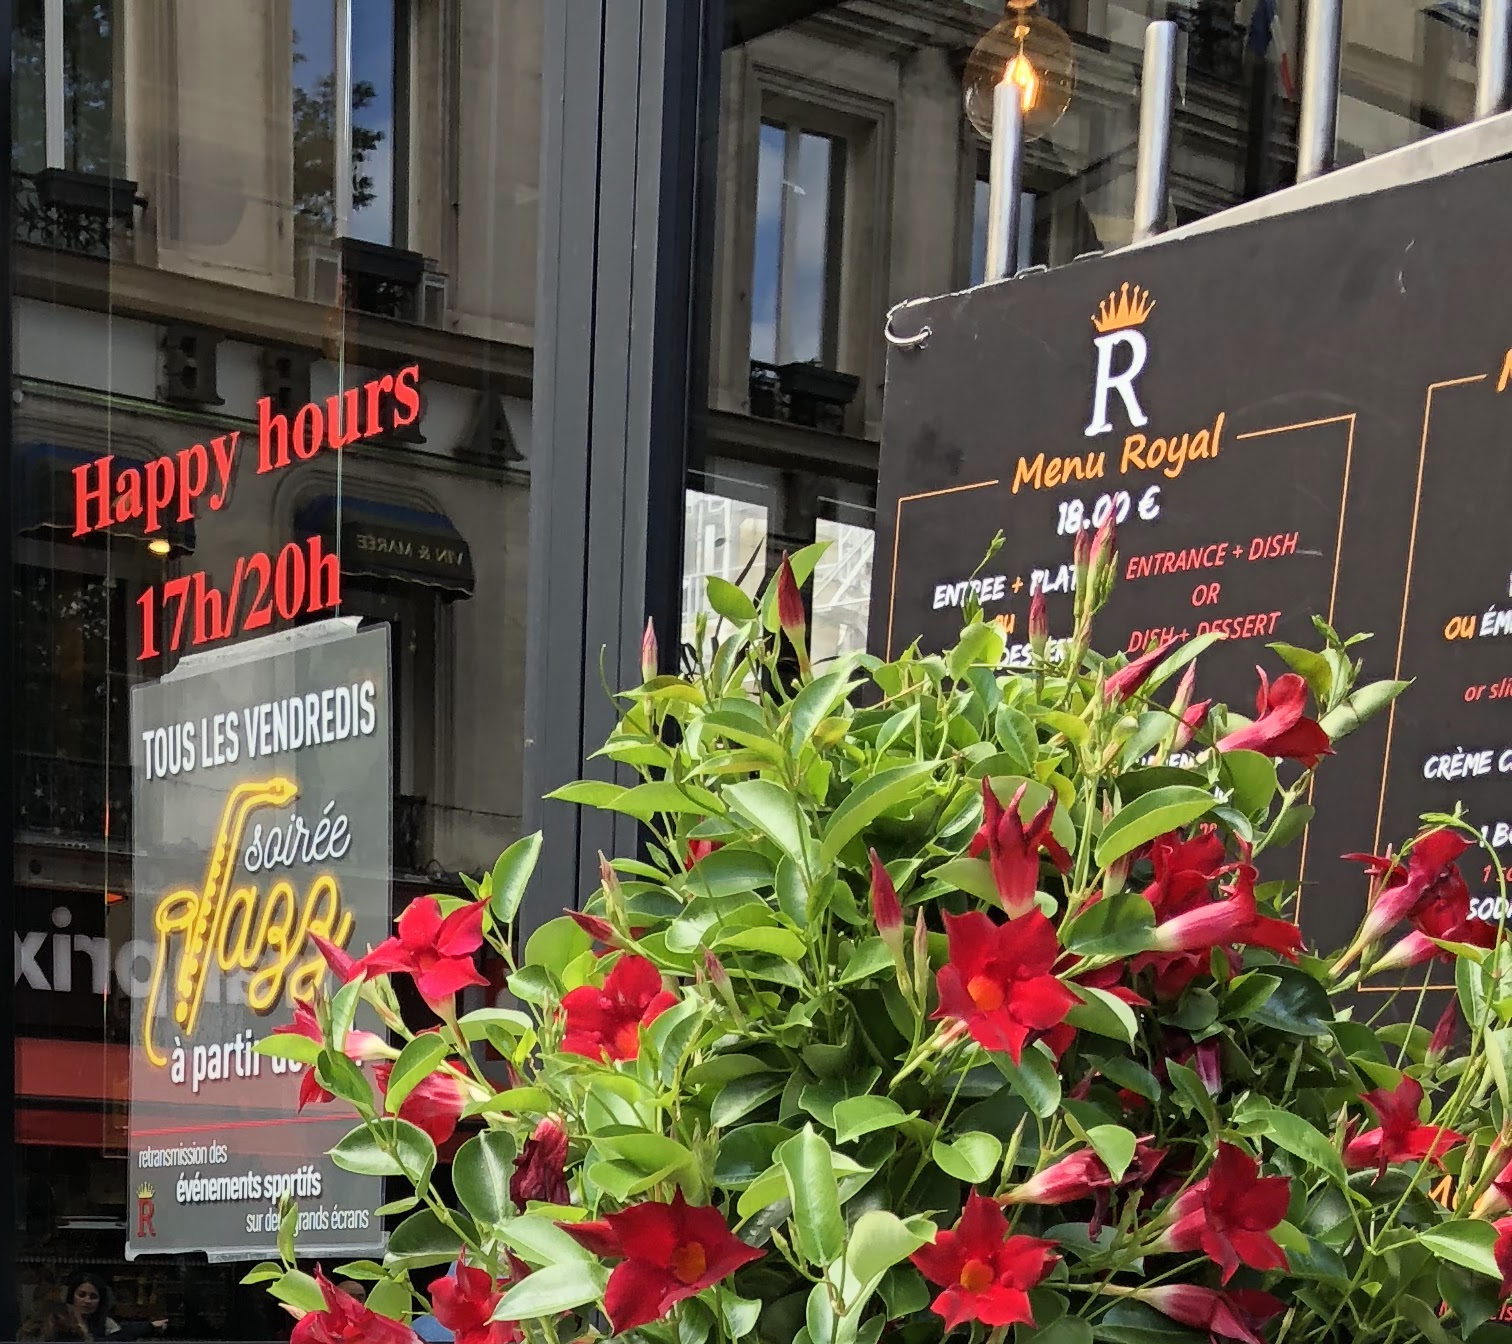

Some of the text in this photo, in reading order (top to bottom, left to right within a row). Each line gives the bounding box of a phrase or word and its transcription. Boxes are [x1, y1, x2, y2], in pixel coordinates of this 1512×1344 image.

[1084, 329, 1150, 437] R
[72, 364, 420, 538] Happy hours
[1011, 411, 1226, 495] Menu Royal
[1138, 484, 1162, 521] €
[1126, 541, 1229, 581] ENTRANCE
[1248, 532, 1300, 562] DISH
[136, 535, 343, 662] 17h/20h
[1029, 564, 1079, 598] PLAT
[1191, 582, 1220, 608] OR
[1196, 611, 1282, 641] DESSERT
[1444, 604, 1512, 640] OU ÉM
[1464, 684, 1487, 702] or
[142, 680, 377, 780] TOUS LES VENDREDIS
[1423, 745, 1494, 781] CRÈME
[244, 800, 352, 872] soirée
[1466, 896, 1512, 921] SOD
[171, 1029, 260, 1093] à partir
[138, 1139, 228, 1168] retransmission des
[176, 1165, 322, 1204] événements sportifs
[137, 1199, 156, 1238] R
[246, 1212, 263, 1233] sur
[331, 1203, 369, 1230] écrans
